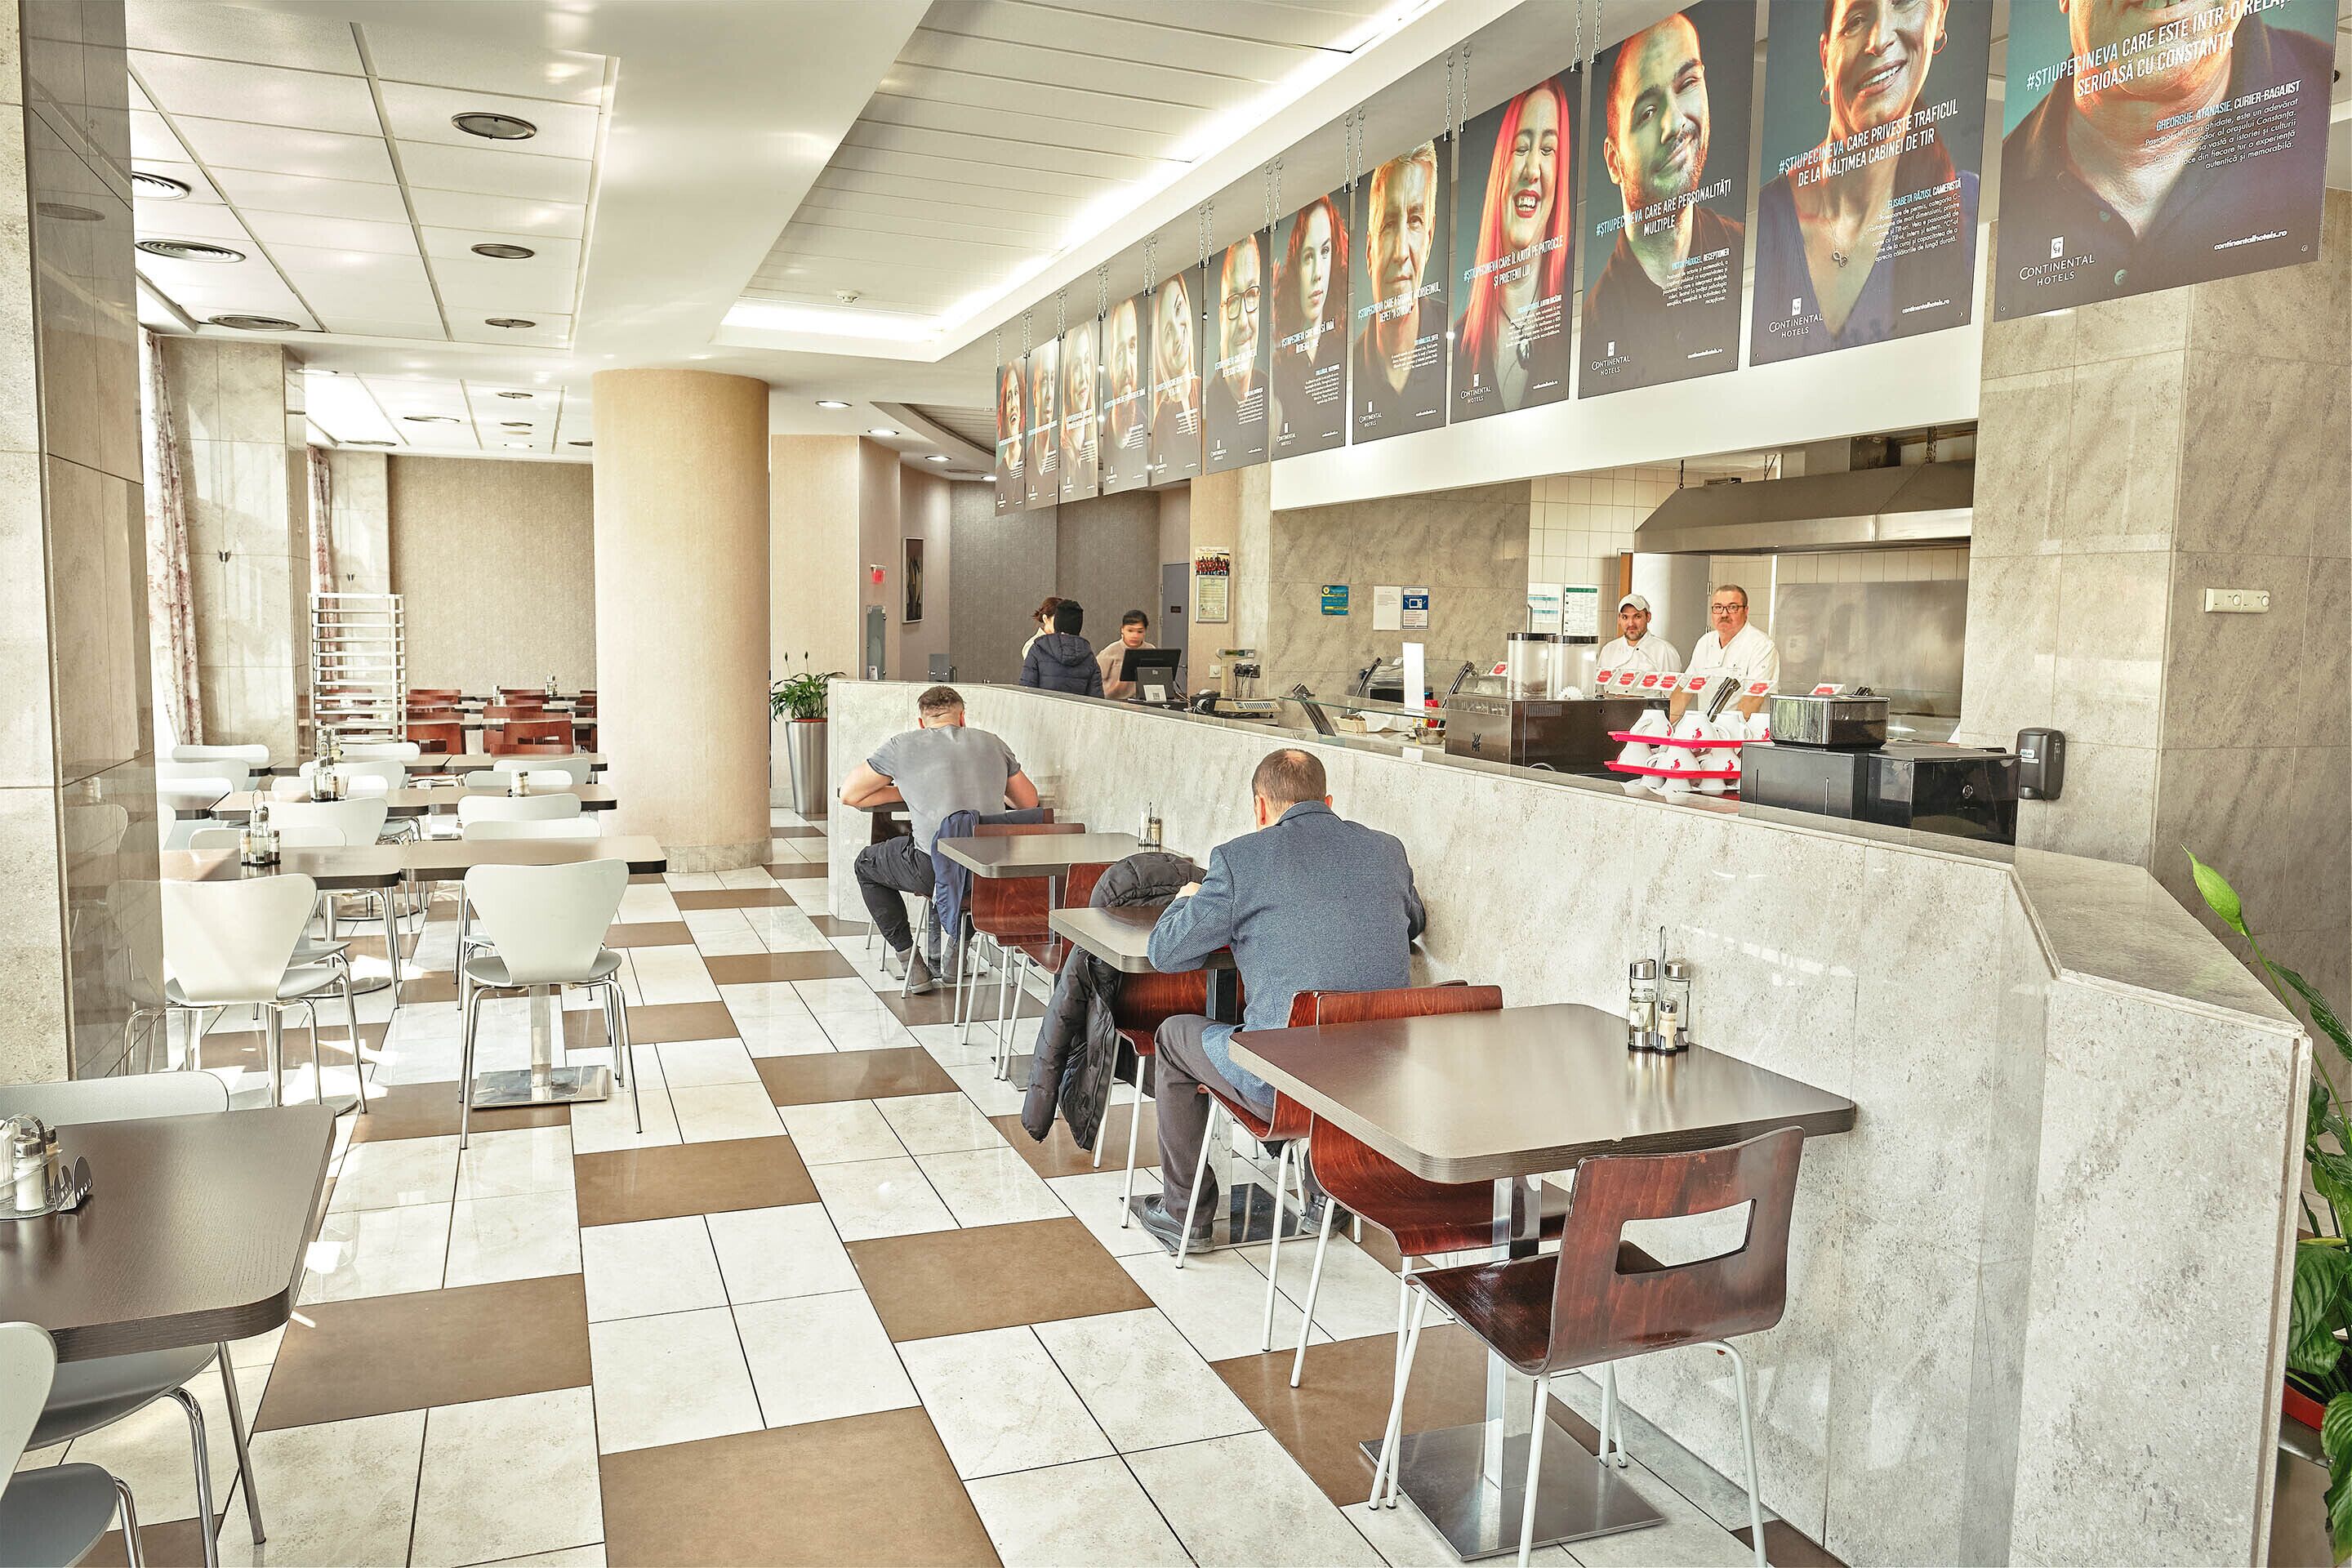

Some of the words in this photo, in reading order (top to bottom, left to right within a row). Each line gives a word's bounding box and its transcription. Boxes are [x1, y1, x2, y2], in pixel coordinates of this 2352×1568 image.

[2026, 43, 2118, 91] #ȘTIUPECINEVA
[2123, 29, 2154, 56] CARE
[2159, 18, 2188, 47] ESTE
[2077, 63, 2134, 97] SERIOASĂ
[2136, 58, 2159, 77] CU
[2158, 31, 2234, 69] CONSTANȚA
[2156, 112, 2194, 131] GHEORGHE
[2205, 118, 2234, 132] ghidate,
[2236, 113, 2251, 121] este
[2253, 109, 2261, 118] un
[2264, 98, 2298, 114] adevărat
[1779, 140, 1843, 176] #ȘTIUPECINEVA
[1846, 130, 1869, 152] CARE
[1871, 115, 1912, 143] PRIVEȘTE
[1914, 98, 1958, 127] TRAFICUL
[2198, 144, 2206, 152] sa
[2208, 136, 2227, 148] vastă
[2236, 129, 2261, 141] istoriei
[2271, 119, 2296, 132] culturii
[2217, 127, 2225, 136] al
[1798, 171, 1809, 187] DE
[1811, 166, 1821, 184] LA
[1869, 140, 1904, 163] CABINEI
[1905, 135, 1918, 152] DE
[1919, 127, 1935, 147] TIR
[2198, 151, 2209, 161] din
[2211, 146, 2235, 158] fiecare
[2237, 142, 2247, 150] tur
[2256, 130, 2296, 147] experiență
[2205, 154, 2238, 169] autentică
[2248, 141, 2294, 158] memorabilă.
[1645, 205, 1662, 220] CARE
[1664, 197, 1677, 216] ARE
[1643, 214, 1676, 237] MULTIPLE
[2213, 229, 2287, 251] continentalhotels.ro
[2019, 254, 2095, 280] CONTINENTAL
[2037, 271, 2075, 287] HOTELS
[1781, 327, 1809, 339] HOTELS
[1600, 366, 1620, 376] HOTELS
